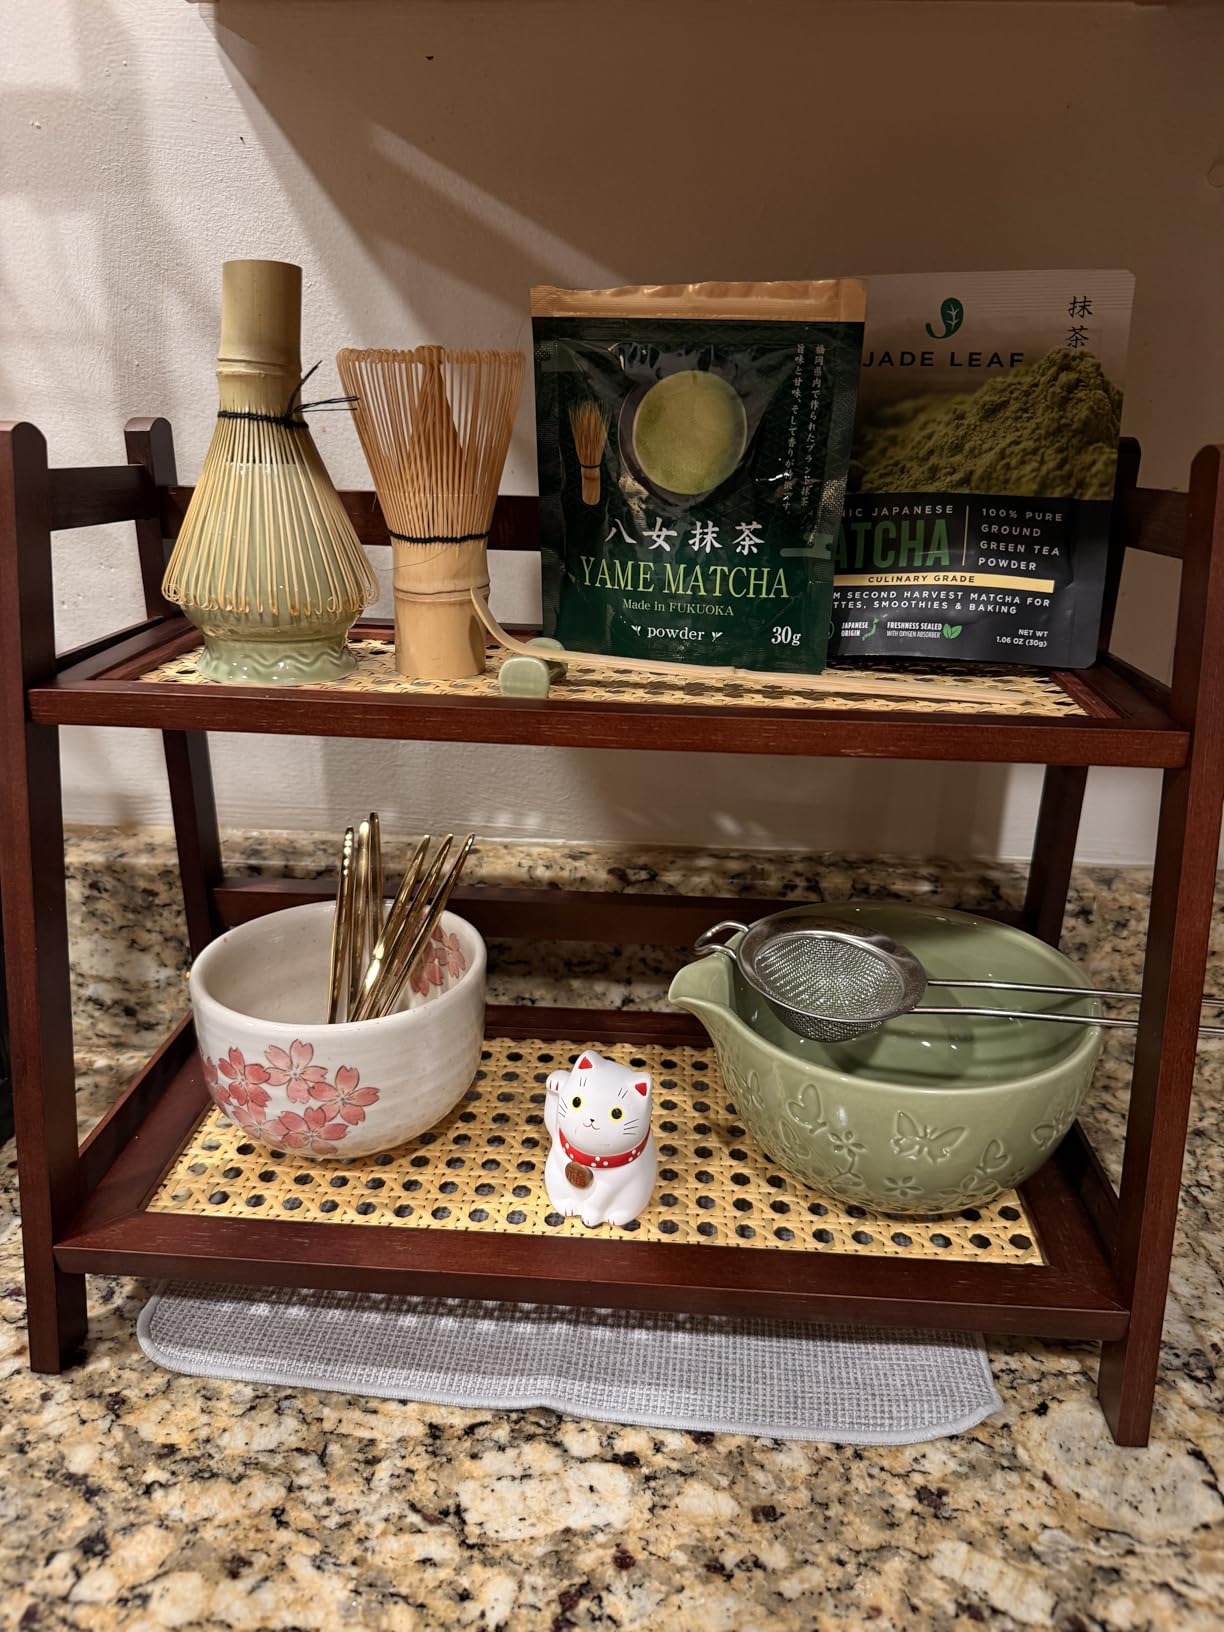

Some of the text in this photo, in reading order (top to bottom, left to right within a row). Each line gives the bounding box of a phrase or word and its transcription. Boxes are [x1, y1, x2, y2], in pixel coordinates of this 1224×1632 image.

[1065, 295, 1093, 349] 抹茶
[862, 351, 1025, 368] JADE LEAF
[872, 505, 954, 517] JAPANESE
[982, 508, 1063, 522] 100% PURE
[604, 516, 766, 556] 八女抹茶
[981, 524, 1041, 537] GROUND
[980, 540, 1060, 556] GREEN TEA
[978, 557, 1037, 571] POWDER
[580, 555, 790, 598] YAME MATCHA
[868, 575, 976, 584] CULINARY GRADE
[847, 590, 897, 599] SECOND
[904, 590, 963, 600] HARVEST
[970, 592, 1020, 604] MATCHA
[1026, 597, 1050, 607] FOR
[623, 598, 734, 616] Made in FUKUOKA
[873, 600, 948, 610] SMOOTHIES
[955, 601, 962, 611] &
[969, 603, 1017, 615] BAKING
[841, 621, 869, 630] JAPANESE
[887, 621, 943, 632] FRESHNESS SEALED
[647, 625, 705, 642] powder
[771, 626, 801, 646] 30g
[841, 629, 861, 638] ORIGIN
[899, 630, 917, 638] OXYGEN
[1019, 629, 1035, 637] NET
[996, 636, 1012, 645] 1.06
[1025, 639, 1048, 648] (30g)
